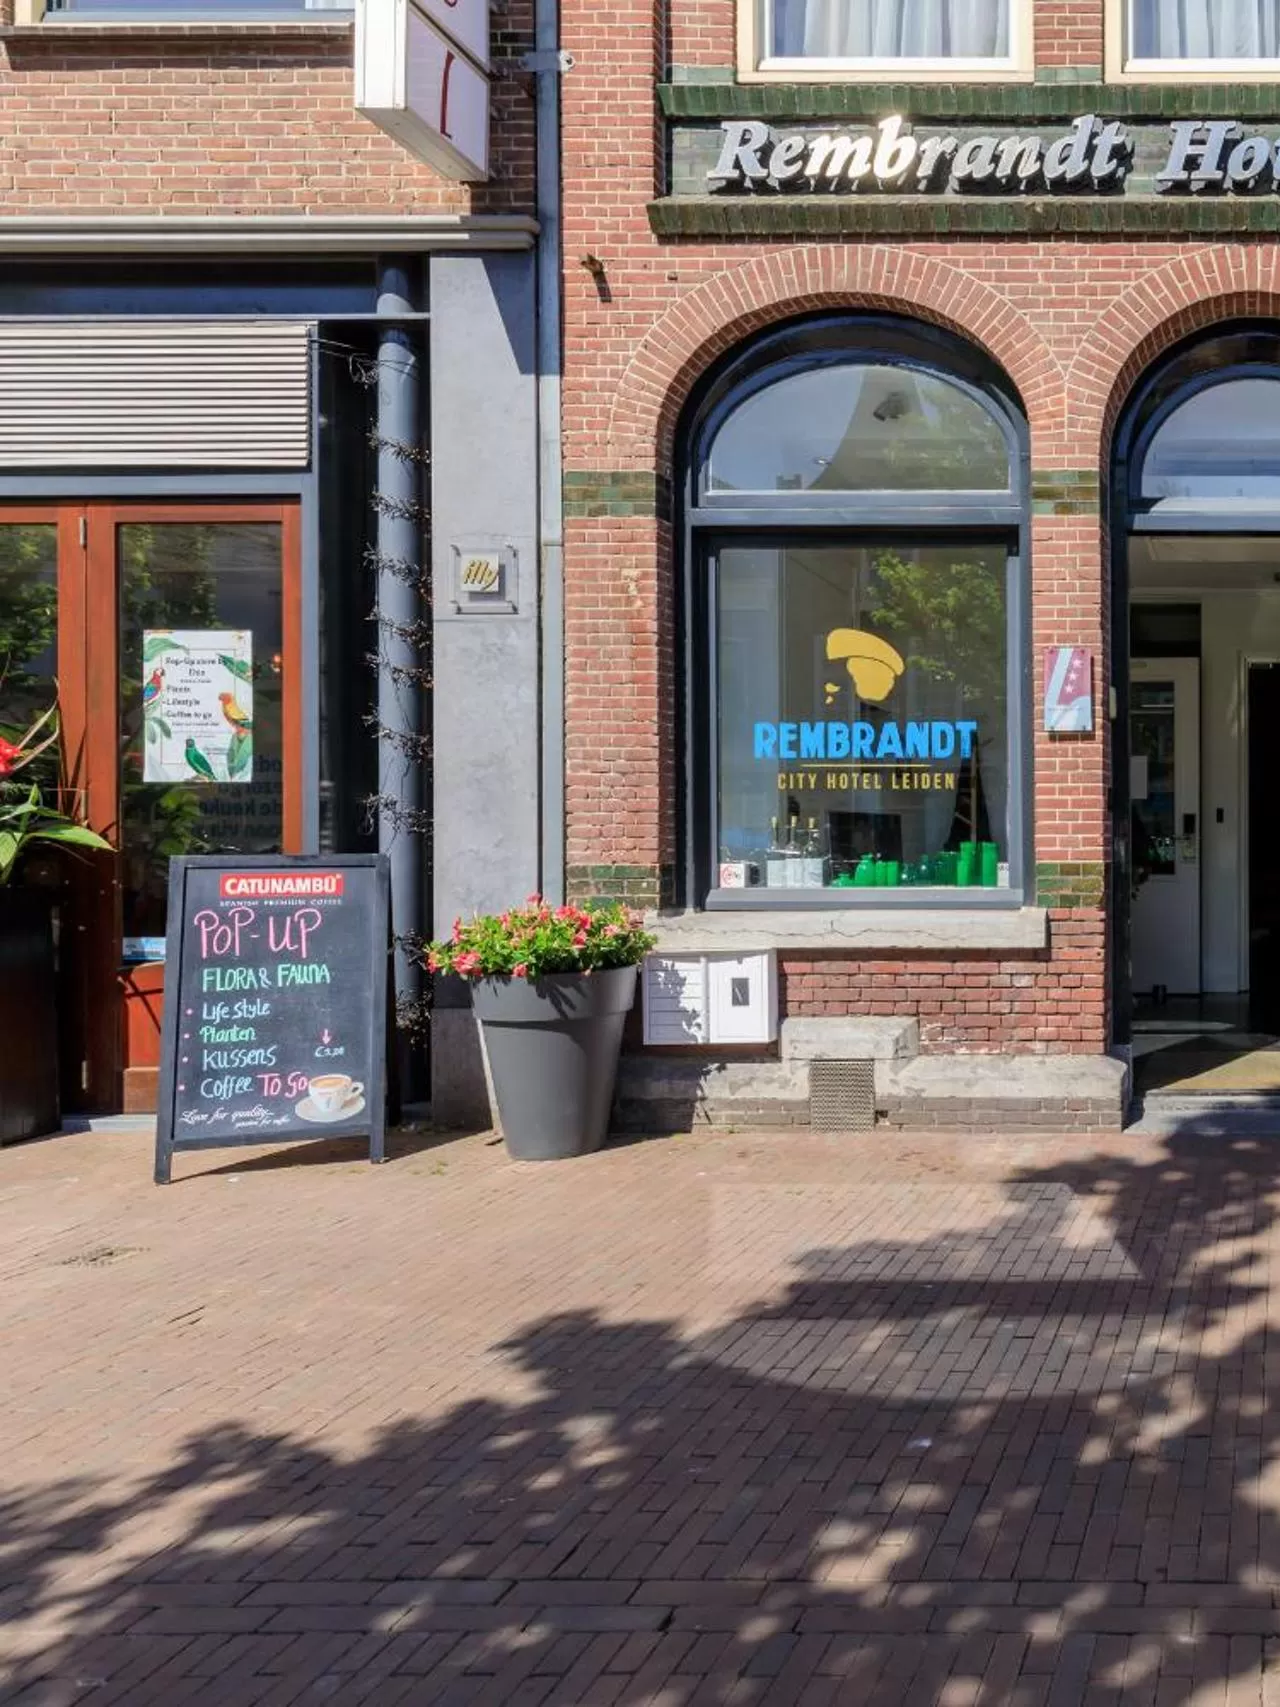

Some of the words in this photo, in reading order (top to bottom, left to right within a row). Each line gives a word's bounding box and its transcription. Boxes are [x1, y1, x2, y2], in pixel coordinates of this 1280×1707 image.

[707, 113, 1127, 181] Rembrandt
[754, 721, 977, 759] REMBRANDT
[777, 773, 816, 790] CITY
[826, 773, 882, 790] HOTEL
[892, 773, 955, 790] LEIDEN
[202, 966, 258, 992] FLORA
[199, 1024, 257, 1044] Planten
[200, 1075, 255, 1100] Coffee
